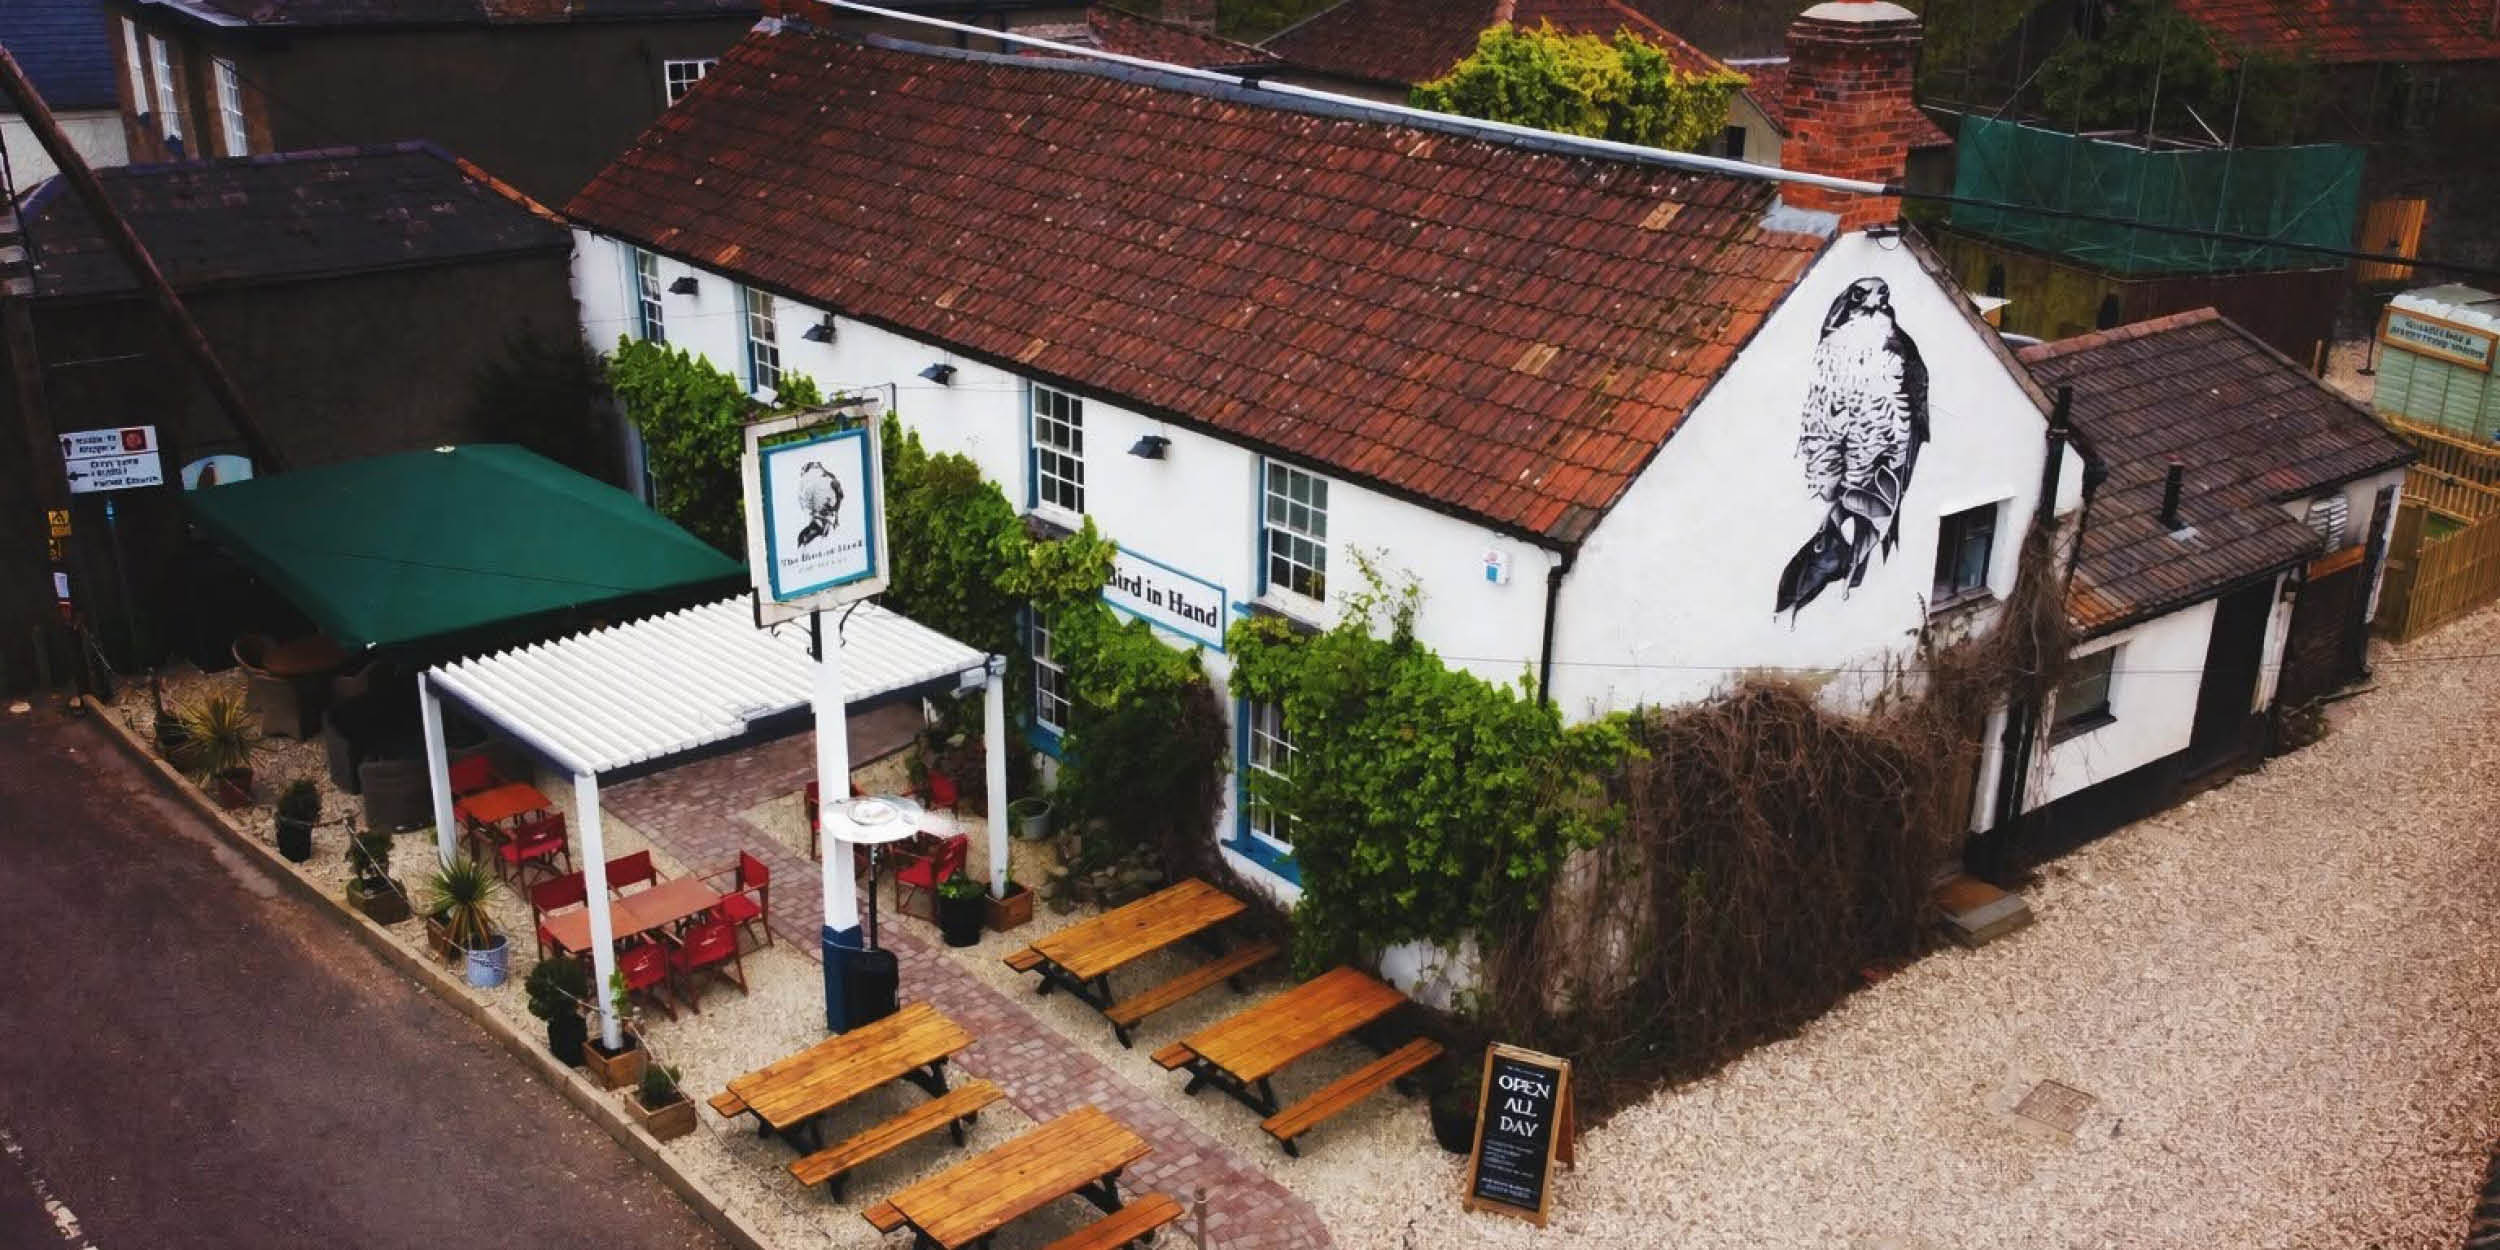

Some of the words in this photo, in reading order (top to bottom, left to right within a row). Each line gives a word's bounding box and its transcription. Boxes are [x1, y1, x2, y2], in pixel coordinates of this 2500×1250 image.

[1146, 579, 1162, 606] in
[1168, 589, 1217, 629] Hand
[1498, 1075, 1550, 1099] OPEN
[1503, 1097, 1537, 1117] ALL
[1500, 1115, 1538, 1137] DAY
